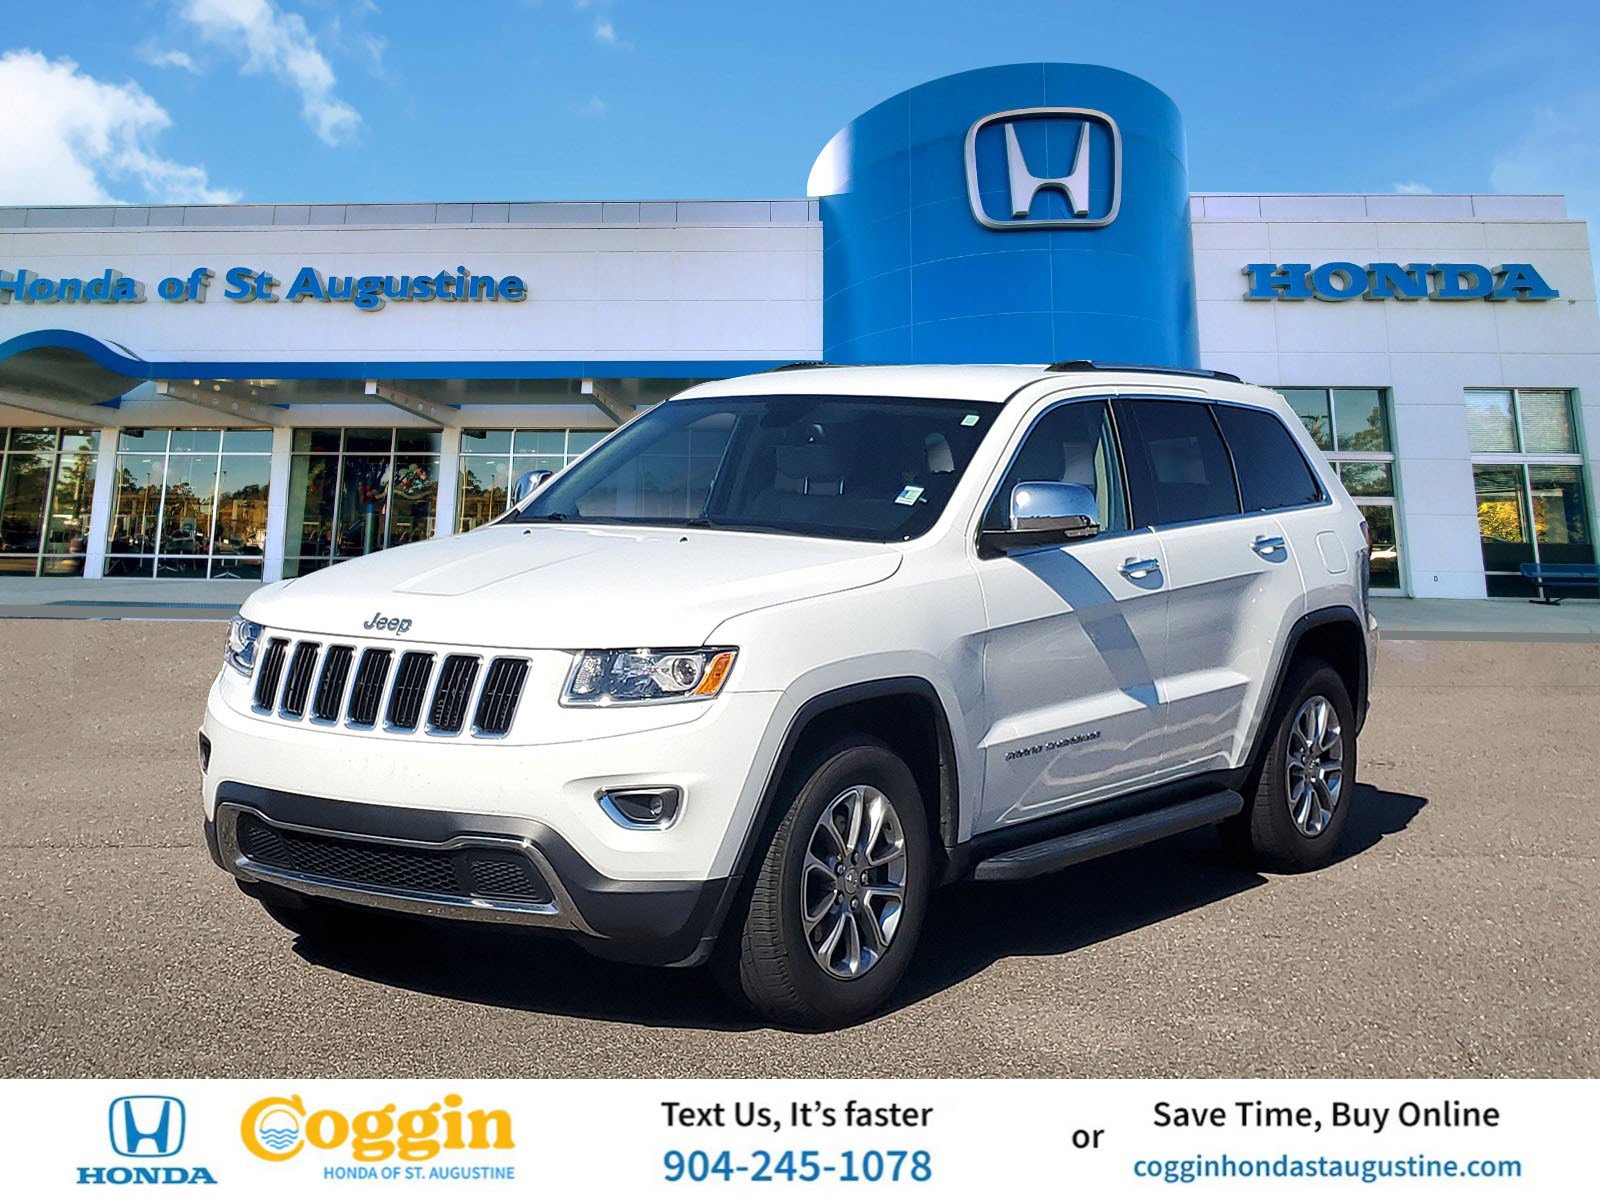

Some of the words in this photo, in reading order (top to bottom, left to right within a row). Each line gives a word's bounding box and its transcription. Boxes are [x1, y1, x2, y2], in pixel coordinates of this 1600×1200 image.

[0, 268, 144, 303] Honda
[158, 267, 214, 303] of
[224, 266, 280, 303] St
[285, 266, 527, 310] Augustine
[1242, 262, 1560, 302] HONDA
[363, 612, 412, 636] Jeep
